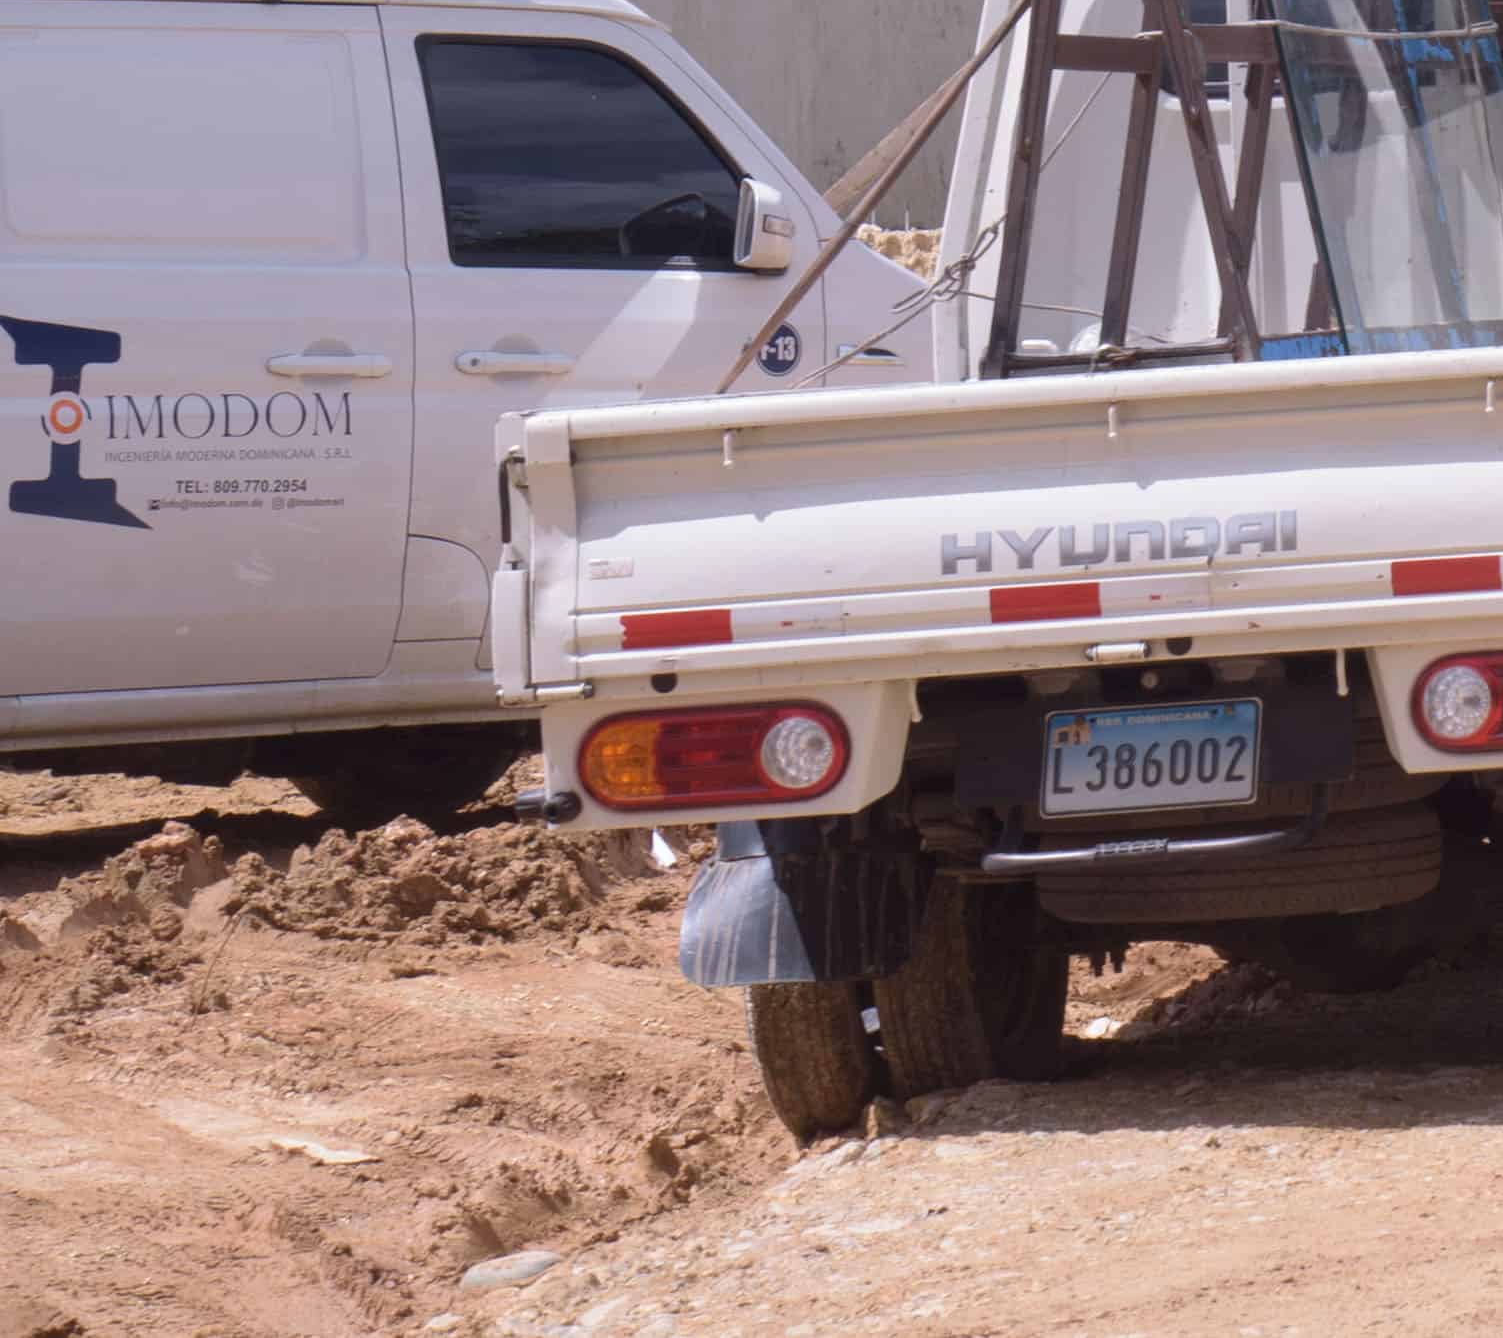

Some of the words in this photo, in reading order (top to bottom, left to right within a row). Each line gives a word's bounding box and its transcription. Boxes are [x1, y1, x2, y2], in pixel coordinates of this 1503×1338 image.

[104, 391, 353, 439] IMODOM
[175, 479, 209, 494] TEL:
[212, 479, 307, 494] 809.770.2954
[940, 509, 1297, 576] HYUNDAI
